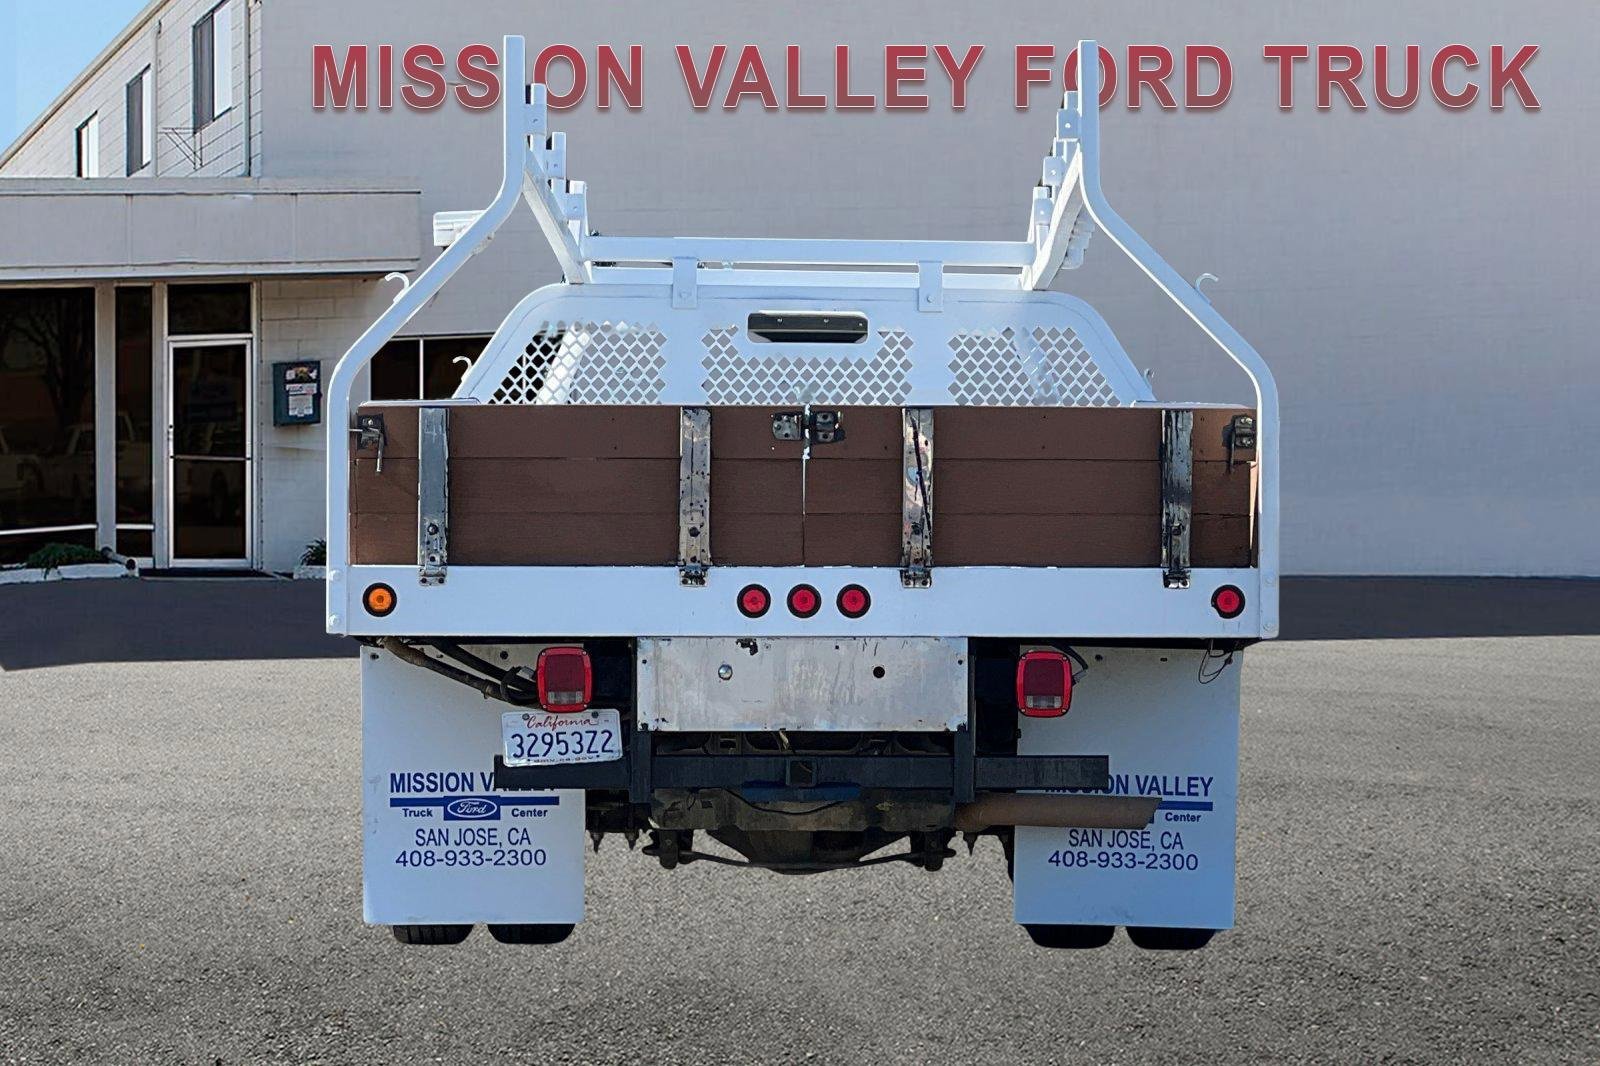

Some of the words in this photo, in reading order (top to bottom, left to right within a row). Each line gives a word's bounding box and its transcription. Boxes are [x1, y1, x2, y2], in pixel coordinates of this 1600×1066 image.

[311, 43, 644, 110] MISSON
[675, 44, 986, 109] VALLEY
[1263, 44, 1542, 109] TRUCK
[526, 715, 592, 731] California
[511, 730, 614, 759] 32953Z2
[390, 772, 474, 793] MISSION
[1135, 774, 1213, 797] VALLEY
[402, 808, 433, 818] Truck
[457, 801, 488, 815] Ford
[511, 808, 548, 818] Center
[1165, 812, 1201, 823] Center
[415, 828, 449, 847] SAN
[454, 828, 502, 849] JOSE,
[507, 827, 532, 846] CA
[1068, 828, 1103, 848] SAN
[1107, 830, 1155, 852] JOSE,
[1160, 831, 1184, 850] CA
[395, 849, 547, 867] 408-933-2300
[1048, 850, 1199, 871] 408-933-2300
